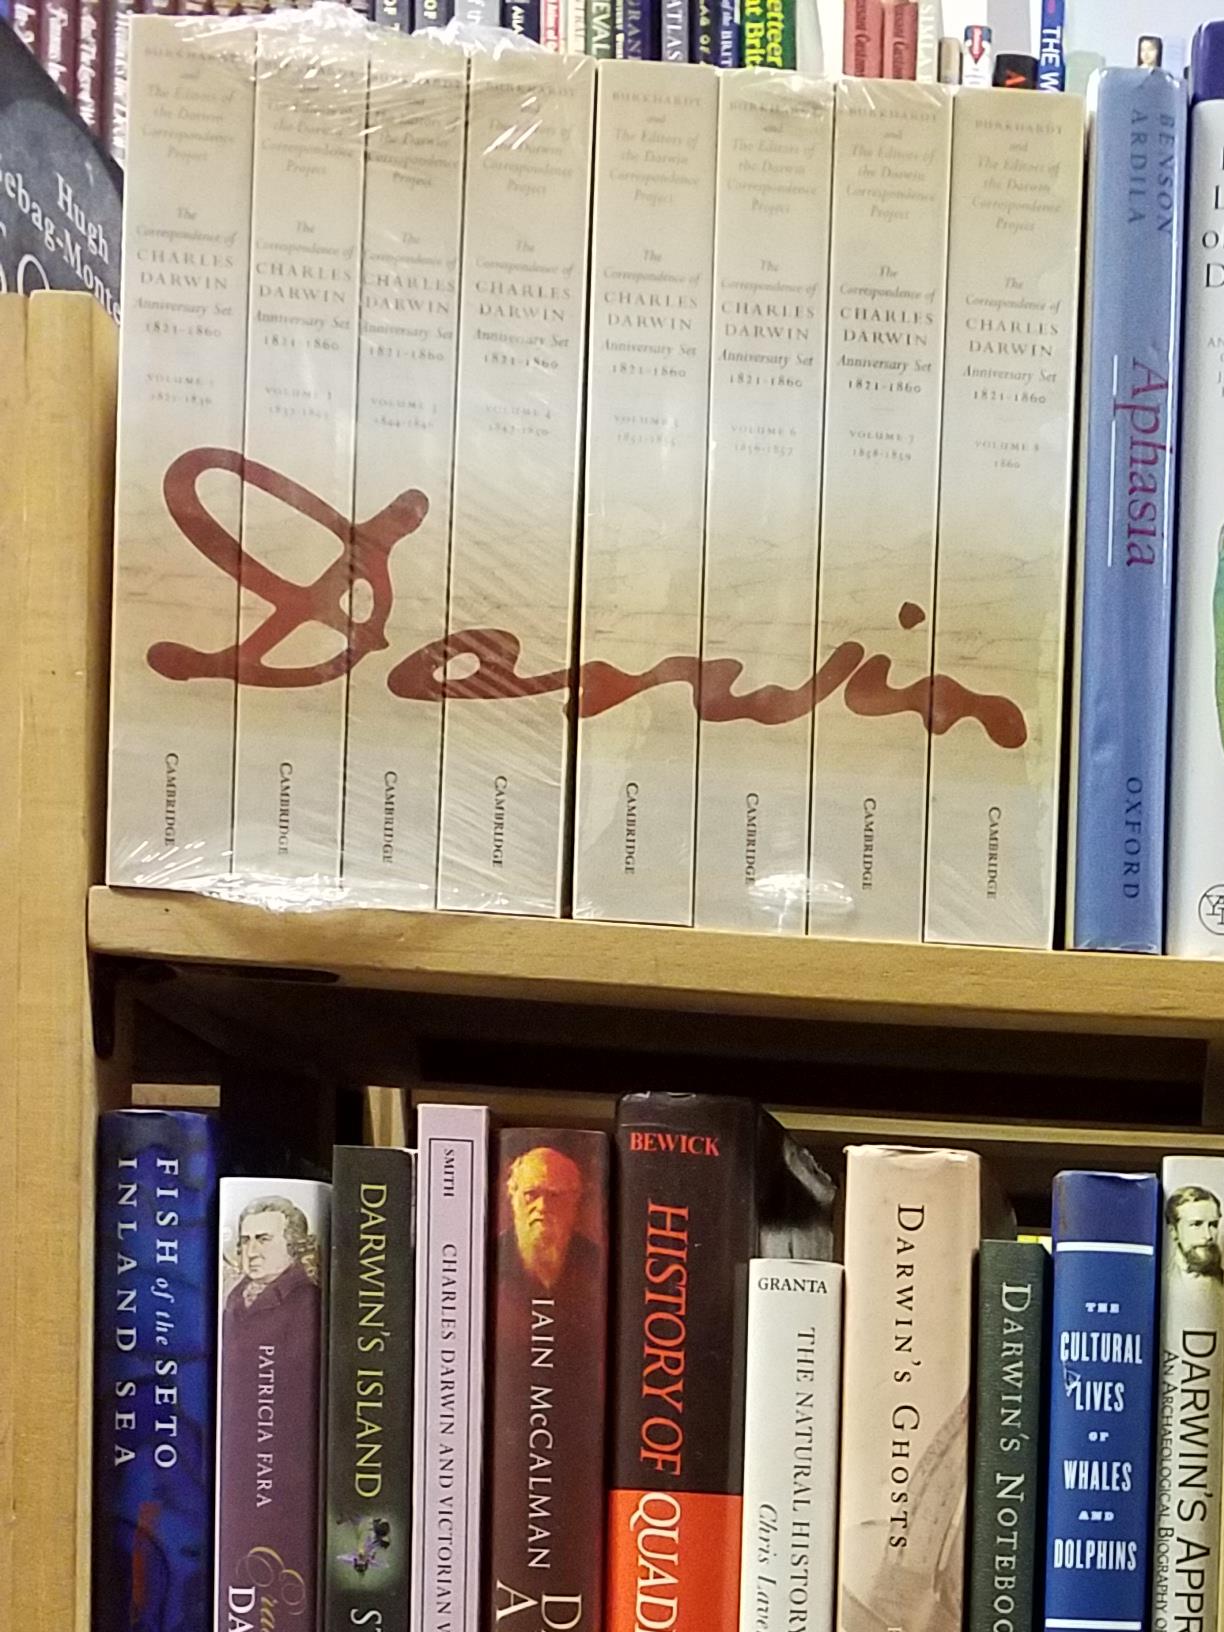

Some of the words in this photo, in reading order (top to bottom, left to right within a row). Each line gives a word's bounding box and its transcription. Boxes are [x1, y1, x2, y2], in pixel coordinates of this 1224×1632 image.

[56, 172, 109, 264] Hugh
[840, 307, 934, 326] CHARLES
[843, 328, 928, 347] DARWIN
[836, 354, 908, 372] Anniversary
[915, 360, 932, 373] Set
[1113, 357, 1173, 567] Aphasia
[146, 447, 1029, 749] Darwin
[622, 781, 641, 876] CAMBRIDGE
[984, 805, 1003, 901] CAMBRIDGE
[1123, 776, 1144, 900] OXFORD
[629, 1132, 720, 1157] BEWICK
[156, 1158, 179, 1265] FISH
[116, 1158, 137, 1352] INLAND
[150, 1277, 175, 1304] of
[357, 1183, 388, 1354] DARWIN'S
[440, 1244, 457, 1341] CHARLES
[758, 1277, 828, 1295] GRANTA
[893, 1204, 925, 1384] DARWIN'S
[155, 1310, 175, 1347] the
[530, 1300, 555, 1369] IAIN
[642, 1199, 689, 1415] HISTORY
[1060, 1331, 1143, 1365] CULTURAL
[1085, 1302, 1119, 1313] THE
[257, 1345, 275, 1443] PATRICIA
[439, 1349, 457, 1435] DARWIN
[795, 1327, 816, 1383] THE
[999, 1283, 1032, 1452] DARWIN'S
[1075, 1382, 1125, 1412] LIVES
[113, 1383, 136, 1467] SEA
[154, 1360, 178, 1470] SETO
[354, 1369, 385, 1499] ISLAND
[639, 1417, 684, 1476] OF
[791, 1391, 815, 1514] NATURAL
[1088, 1431, 1109, 1442] OF
[1176, 1328, 1217, 1523] DARWIN'S
[256, 1452, 273, 1508] FARA
[438, 1442, 455, 1490] AND
[888, 1404, 920, 1549] GHOSTS
[1064, 1461, 1132, 1492] WHALES
[434, 1495, 454, 1615] VICTORIAN
[1053, 1539, 1138, 1571] DOLPHINS
[1078, 1510, 1115, 1521] AND
